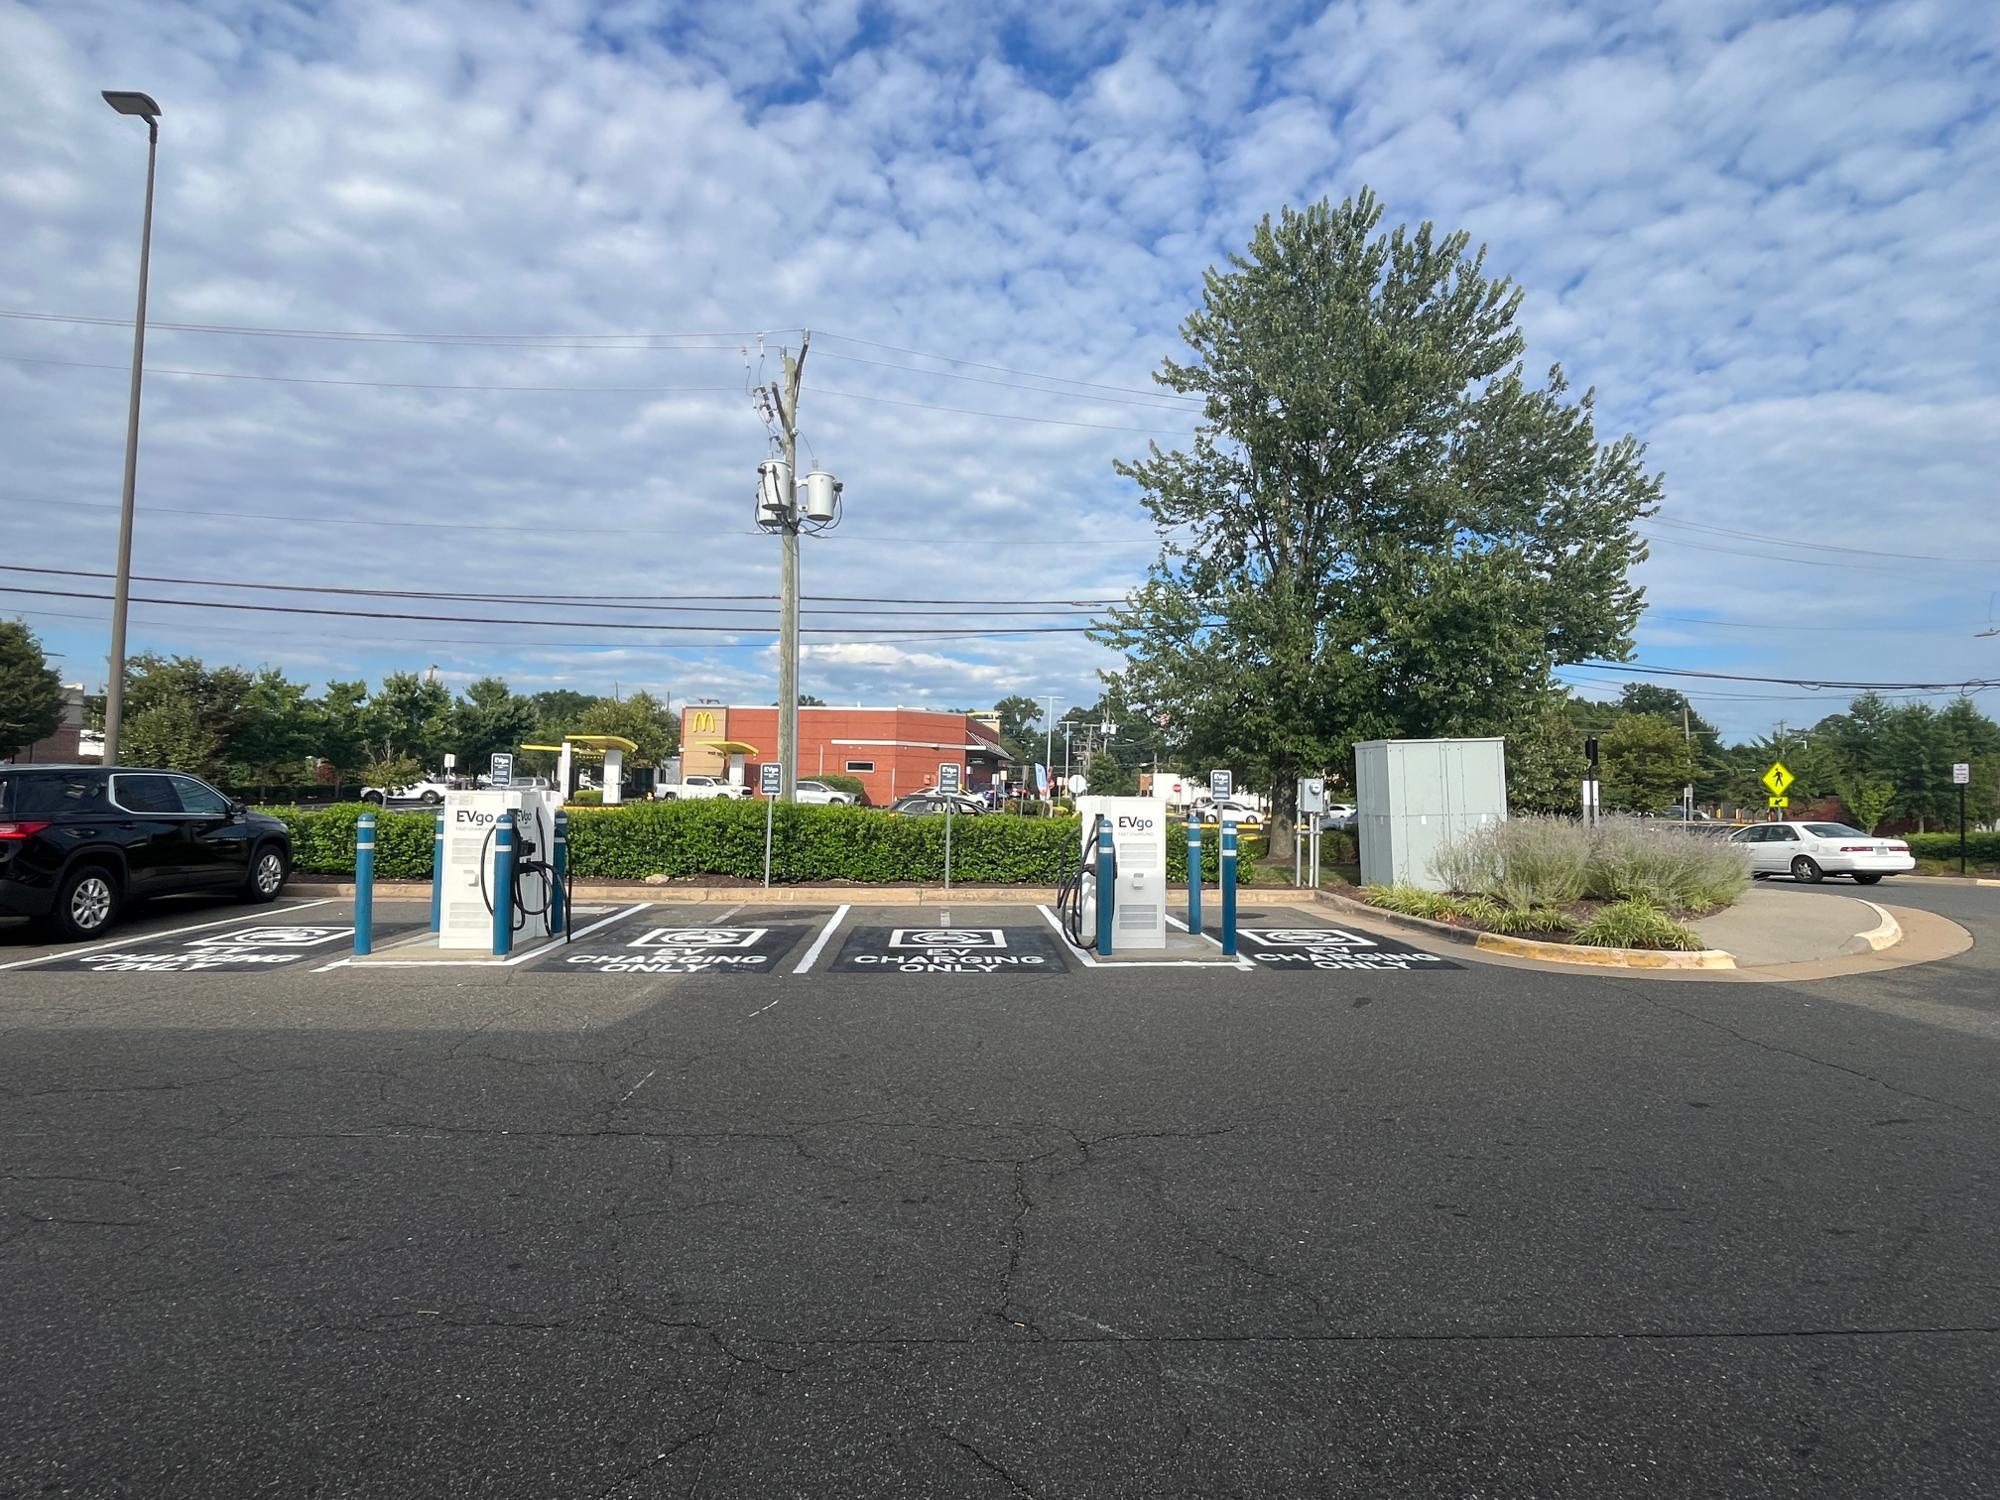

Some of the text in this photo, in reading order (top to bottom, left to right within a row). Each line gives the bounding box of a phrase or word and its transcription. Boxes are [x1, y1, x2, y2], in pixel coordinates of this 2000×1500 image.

[457, 810, 494, 826] EVgo
[1119, 816, 1153, 831] EVgo
[653, 948, 707, 956] EV
[926, 948, 972, 956] EV
[1304, 946, 1350, 954] EV
[566, 955, 768, 964] CHARGING
[854, 955, 1045, 964] CHARGING
[1253, 953, 1442, 962] CHARGING
[600, 963, 712, 972] ONLY
[899, 964, 999, 973] ONLY
[1313, 961, 1411, 970] ONLY
